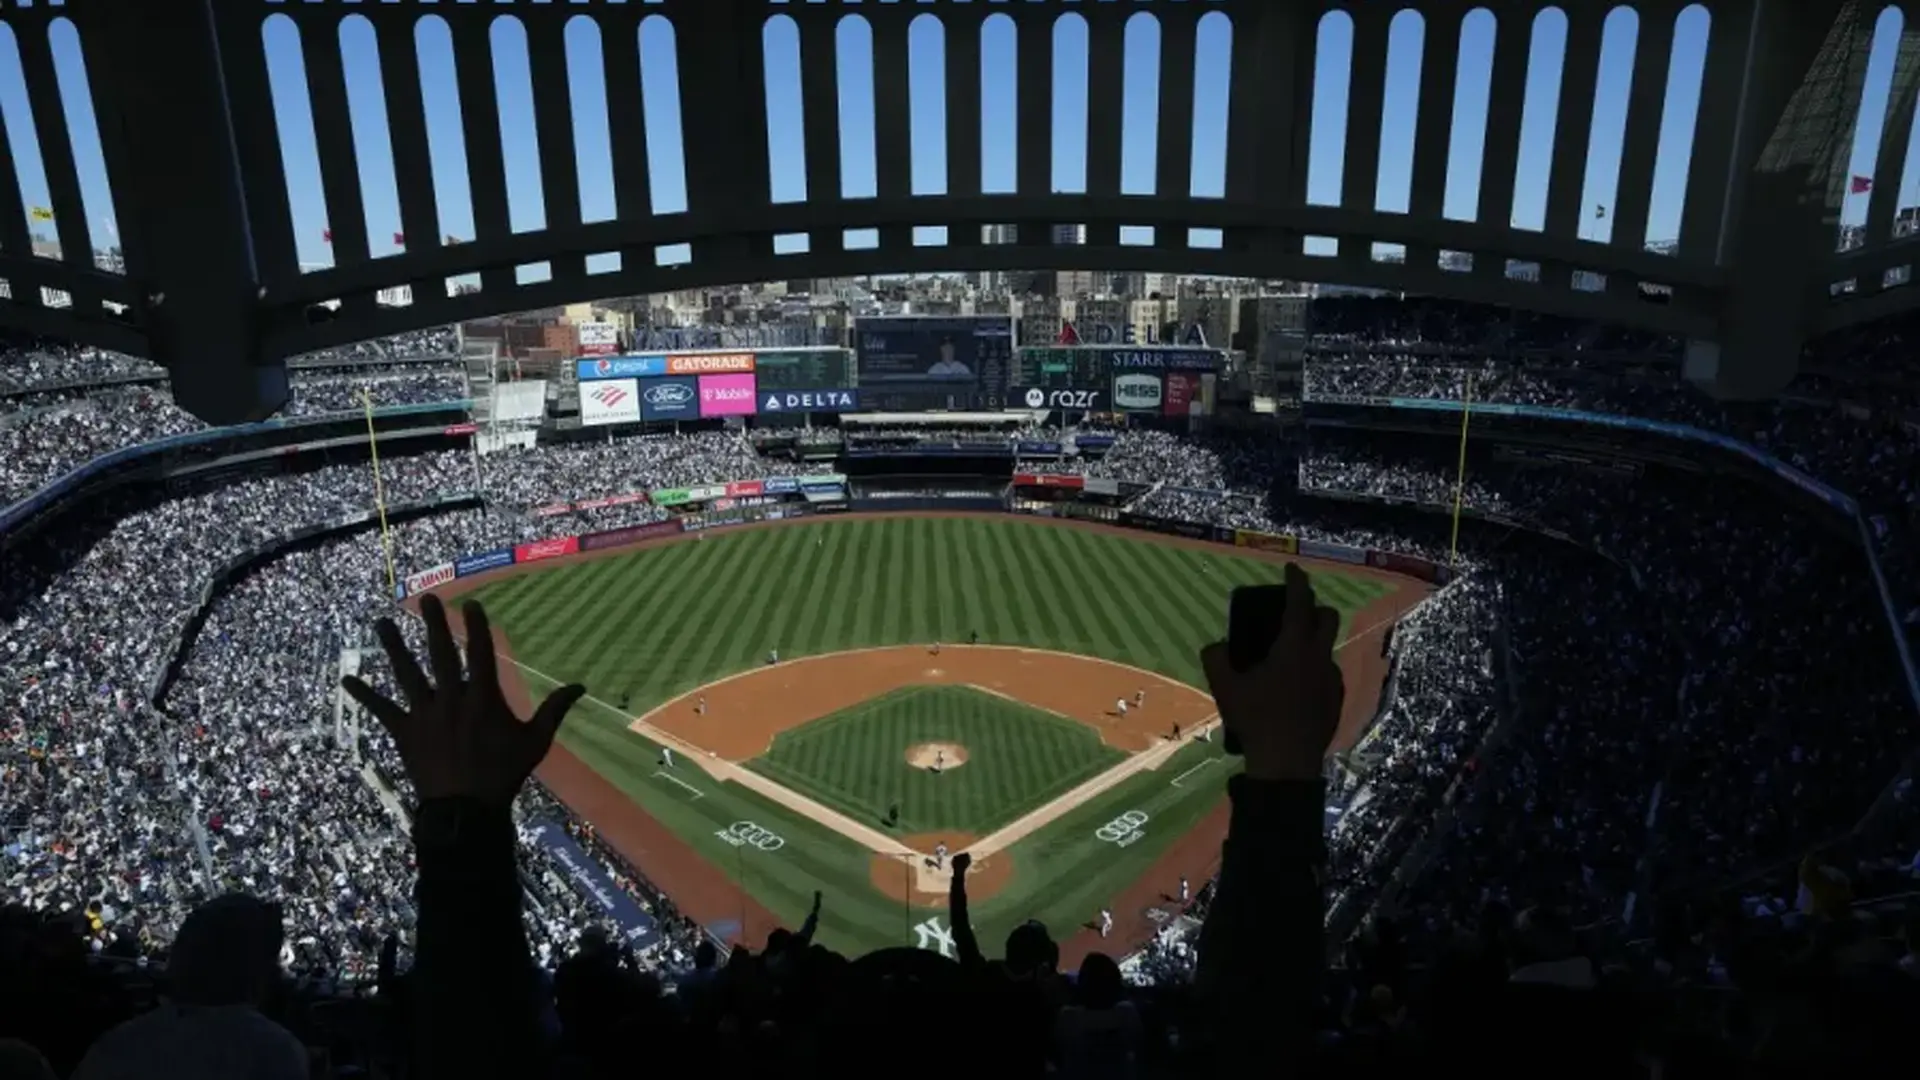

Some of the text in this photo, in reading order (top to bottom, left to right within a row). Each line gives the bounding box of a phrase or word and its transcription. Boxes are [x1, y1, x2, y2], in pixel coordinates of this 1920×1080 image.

[672, 355, 750, 371] GATORADE
[1113, 352, 1164, 367] STARR
[1049, 390, 1099, 407] razr
[1117, 384, 1160, 398] HESS
[786, 392, 852, 407] DELTA
